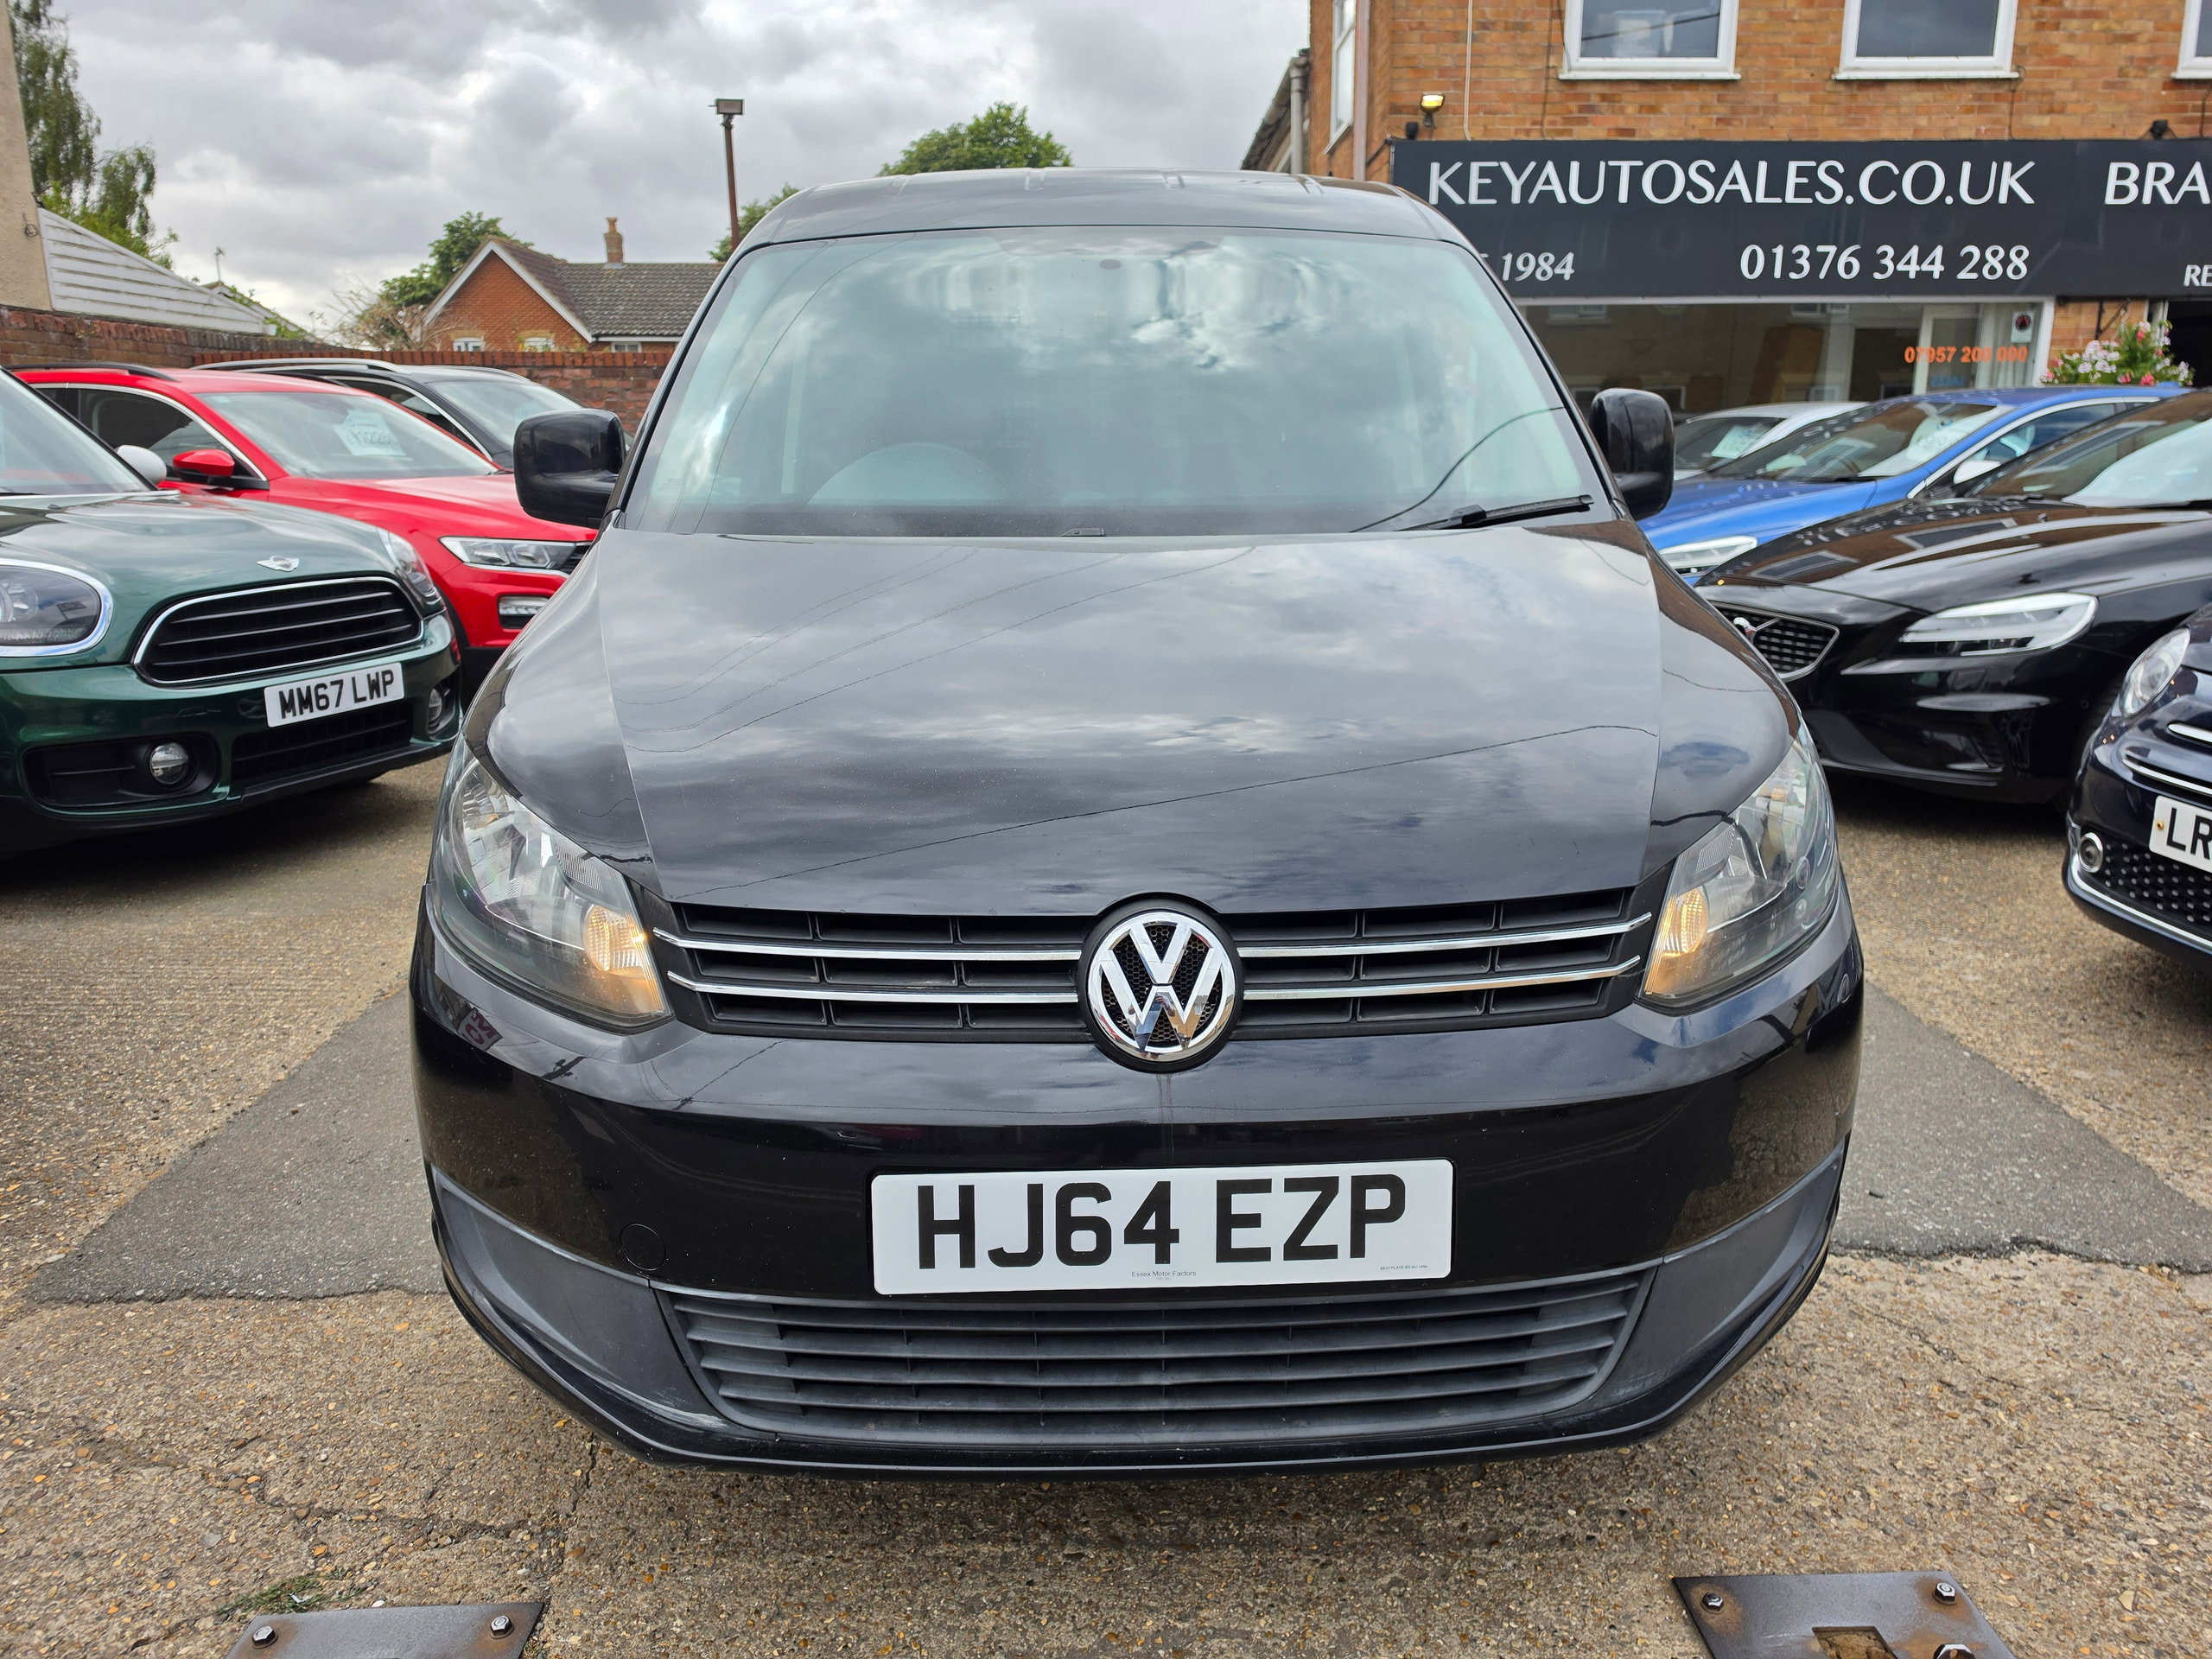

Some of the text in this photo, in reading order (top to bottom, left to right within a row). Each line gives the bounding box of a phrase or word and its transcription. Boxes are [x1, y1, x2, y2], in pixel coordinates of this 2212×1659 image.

[1428, 160, 2035, 205] KEYAUTOSALES.CO.UK
[2105, 161, 2211, 205] BRA
[1502, 251, 1575, 282] 1984
[1740, 244, 2030, 280] 01376 344 288
[1960, 346, 1993, 363] 200
[1996, 346, 2029, 363] 000
[278, 670, 394, 719] MM67 LWP
[2166, 807, 2212, 861] LR
[918, 1173, 1406, 1269] HJ64 EZP
